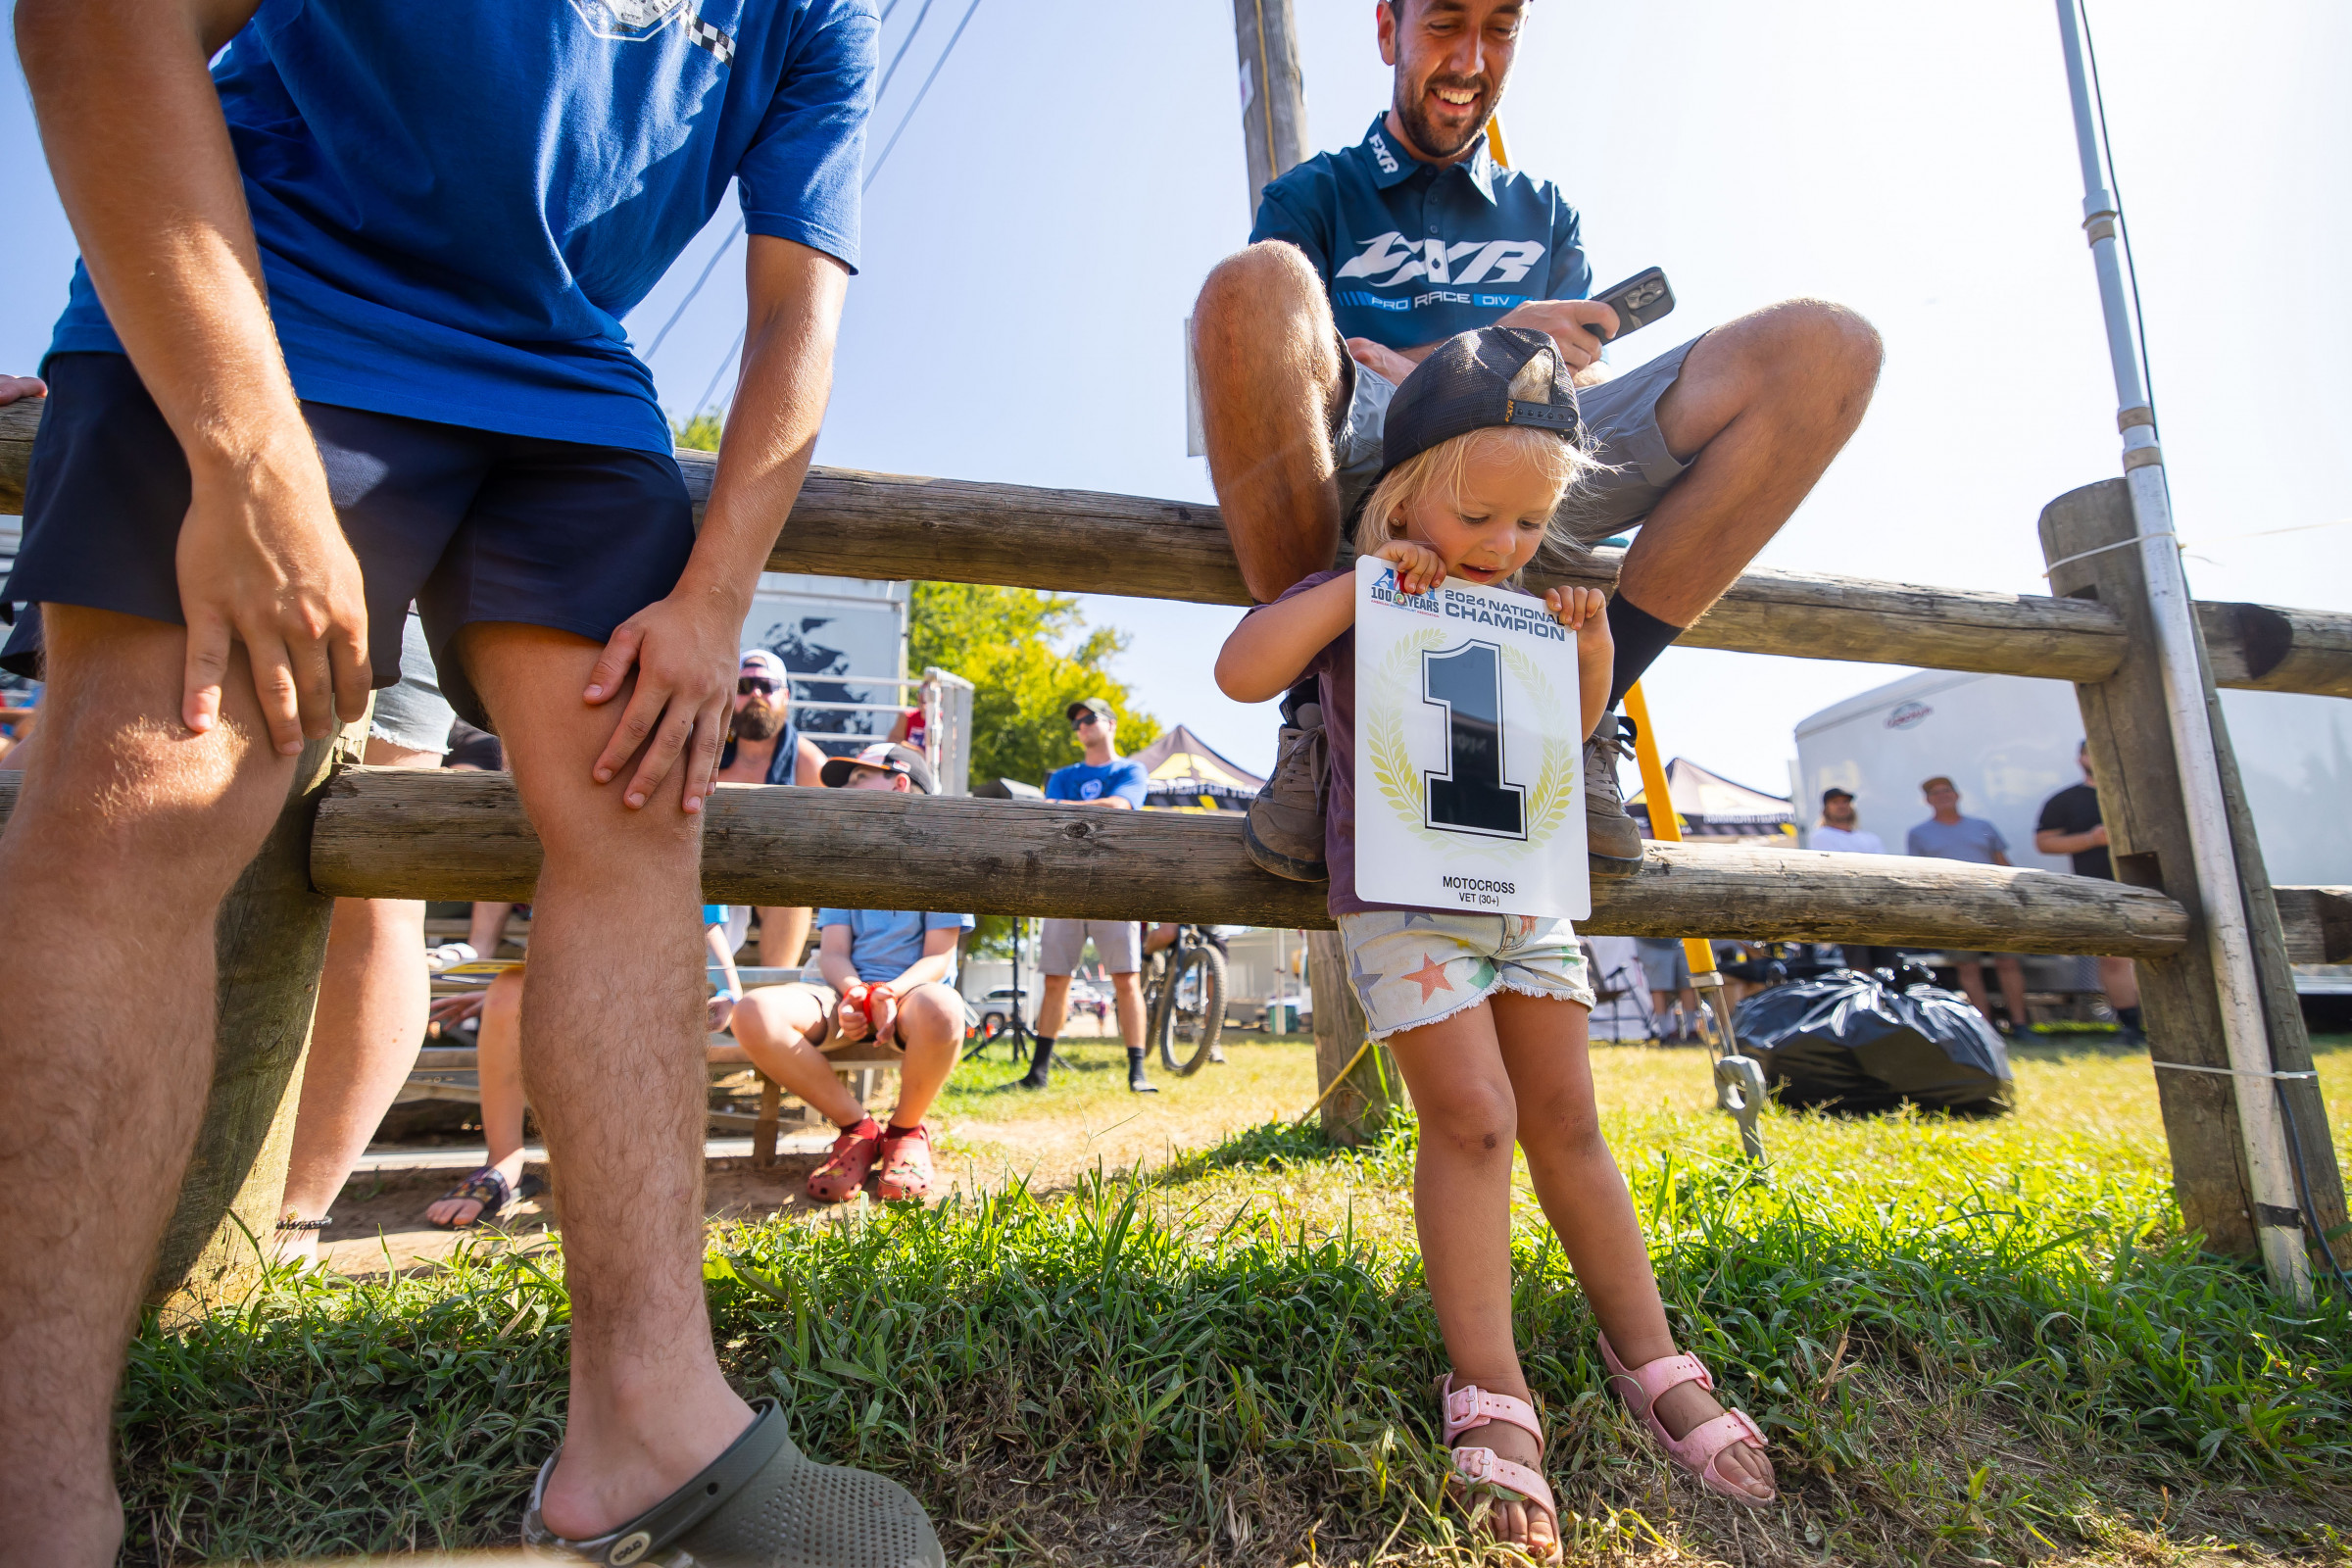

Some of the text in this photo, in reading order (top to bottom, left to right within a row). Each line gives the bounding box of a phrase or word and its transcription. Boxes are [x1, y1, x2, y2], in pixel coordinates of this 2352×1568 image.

[1368, 131, 1399, 174] FXR
[1335, 231, 1546, 287] FXR
[1372, 291, 1510, 311] PRO RACE DIV
[1371, 586, 1440, 613] 100 YEARS
[1445, 589, 1565, 626] 2024 NATIONAL
[1445, 602, 1565, 642] CHAMPION
[1422, 638, 1529, 842] 1
[1443, 875, 1515, 894] MOTOCROSS
[1458, 892, 1499, 906] VET (30+)
